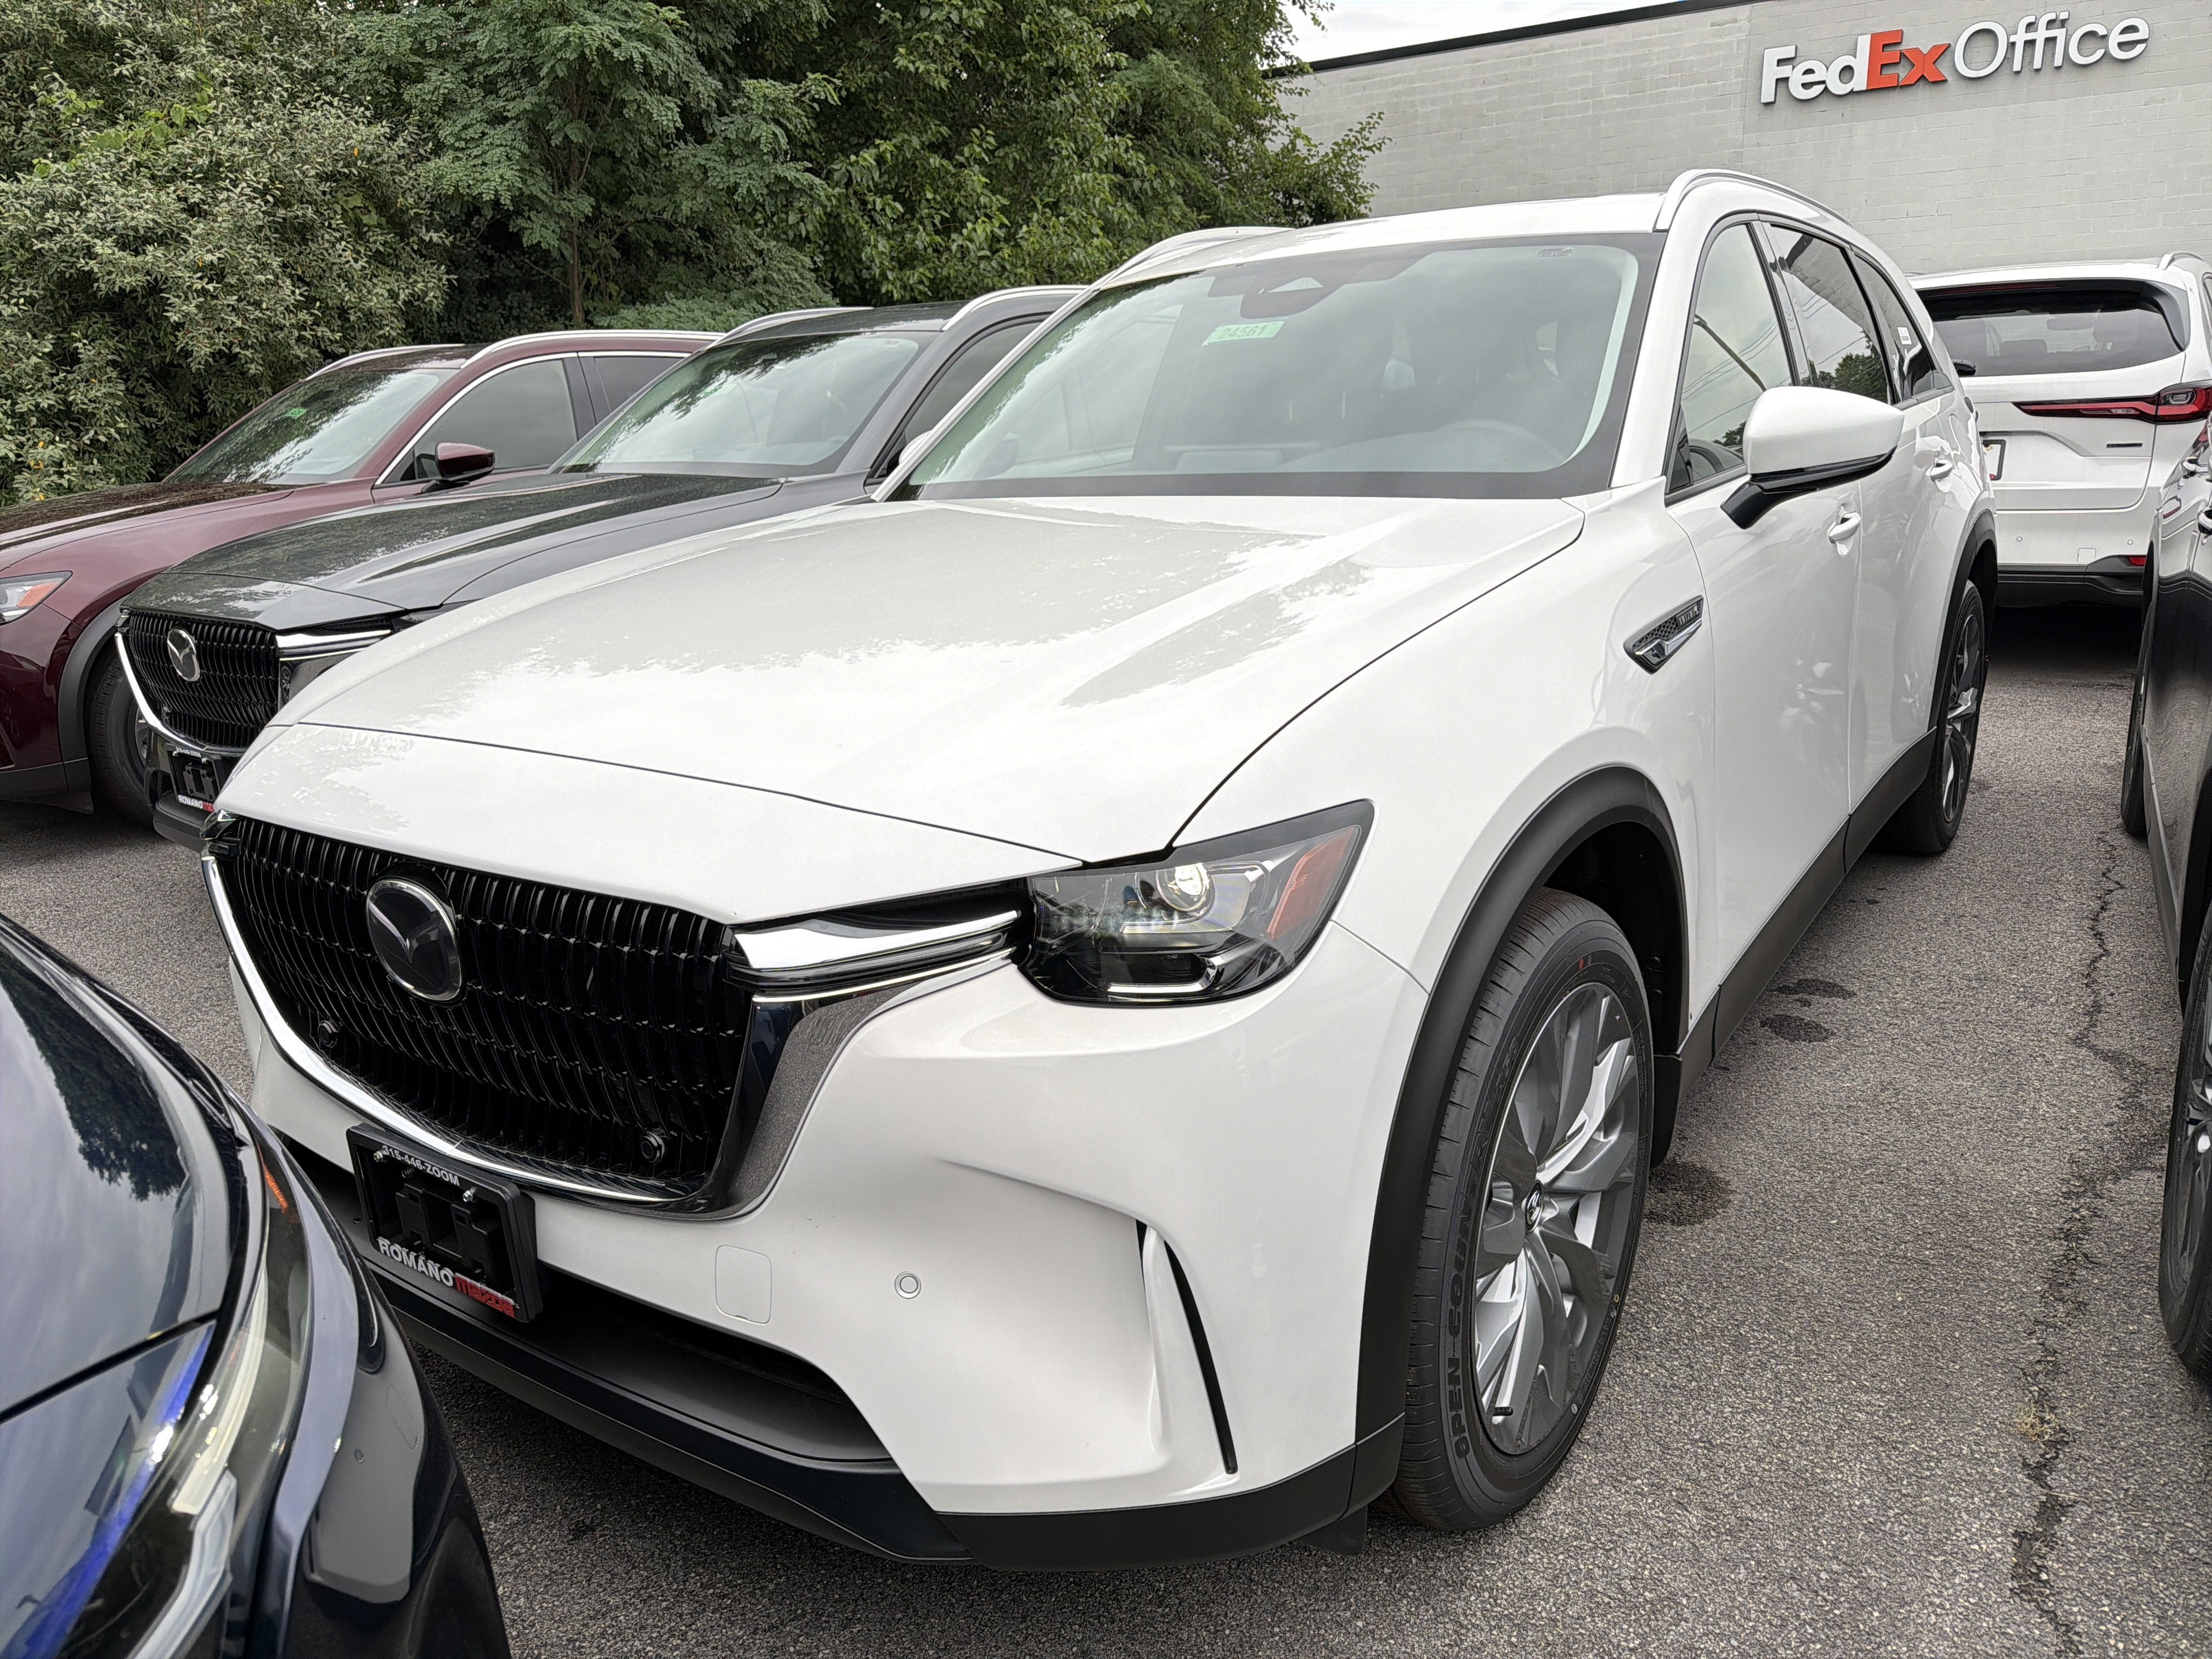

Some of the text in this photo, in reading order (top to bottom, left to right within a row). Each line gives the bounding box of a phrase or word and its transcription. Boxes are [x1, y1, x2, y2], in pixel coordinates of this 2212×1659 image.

[1760, 10, 2151, 104] FedEx Office
[1217, 324, 1268, 339] 24561
[178, 794, 204, 809] ROMANO
[382, 1145, 460, 1187] 315-446-ZOOM
[377, 1236, 454, 1287] ROMANO
[1447, 1357, 1470, 1459] OPEN
